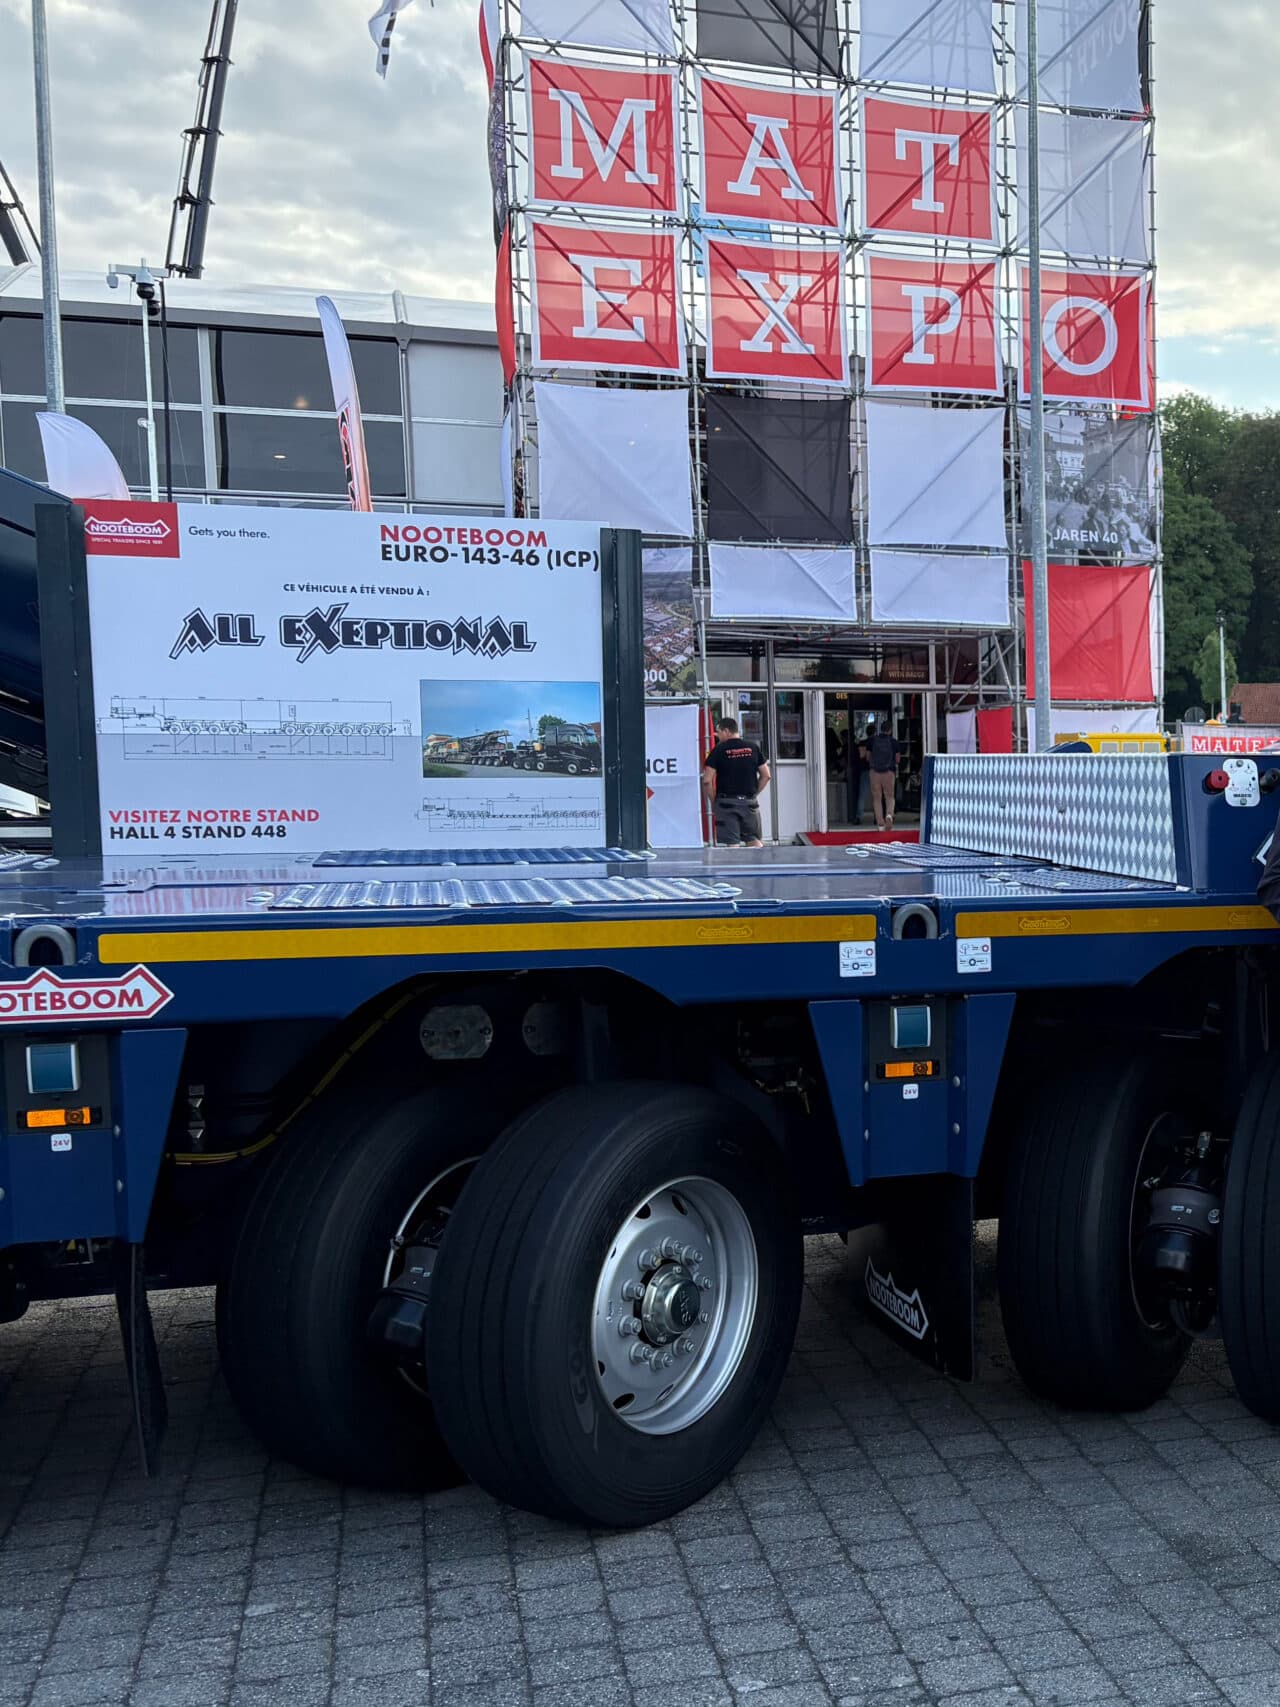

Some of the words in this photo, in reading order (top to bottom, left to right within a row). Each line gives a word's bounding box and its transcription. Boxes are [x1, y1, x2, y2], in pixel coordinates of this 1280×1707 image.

[549, 88, 959, 213] MAT
[569, 254, 1118, 375] EXPO
[90, 523, 162, 535] NOOTEBOOM
[188, 526, 214, 537] Gets
[216, 529, 237, 539] you
[238, 527, 271, 539] there.
[380, 524, 547, 548] NOOTEBOOM
[1054, 529, 1099, 543] JAREN
[1102, 532, 1118, 544] 40
[381, 544, 540, 566] EURO-143-46
[546, 549, 599, 572] (ICP)
[283, 583, 296, 593] CE
[298, 581, 348, 594] VÉHICULE
[350, 586, 358, 594] A
[360, 584, 376, 595] ÉTÉ
[378, 587, 414, 596] VENDU
[416, 585, 424, 596] À
[169, 607, 265, 660] ALL
[280, 602, 537, 663] EXEPTIONAL
[1194, 738, 1280, 752] MATE
[109, 810, 181, 824] VISITEZ
[187, 809, 252, 823] NOTRE
[257, 809, 320, 823] STAND
[110, 826, 159, 840] HALL
[163, 826, 176, 839] 4
[182, 826, 246, 839] STAND
[251, 825, 287, 838] 448
[904, 1087, 917, 1096] 24V
[53, 1139, 70, 1147] 24V
[869, 1276, 921, 1330] NOOTEBOOM
